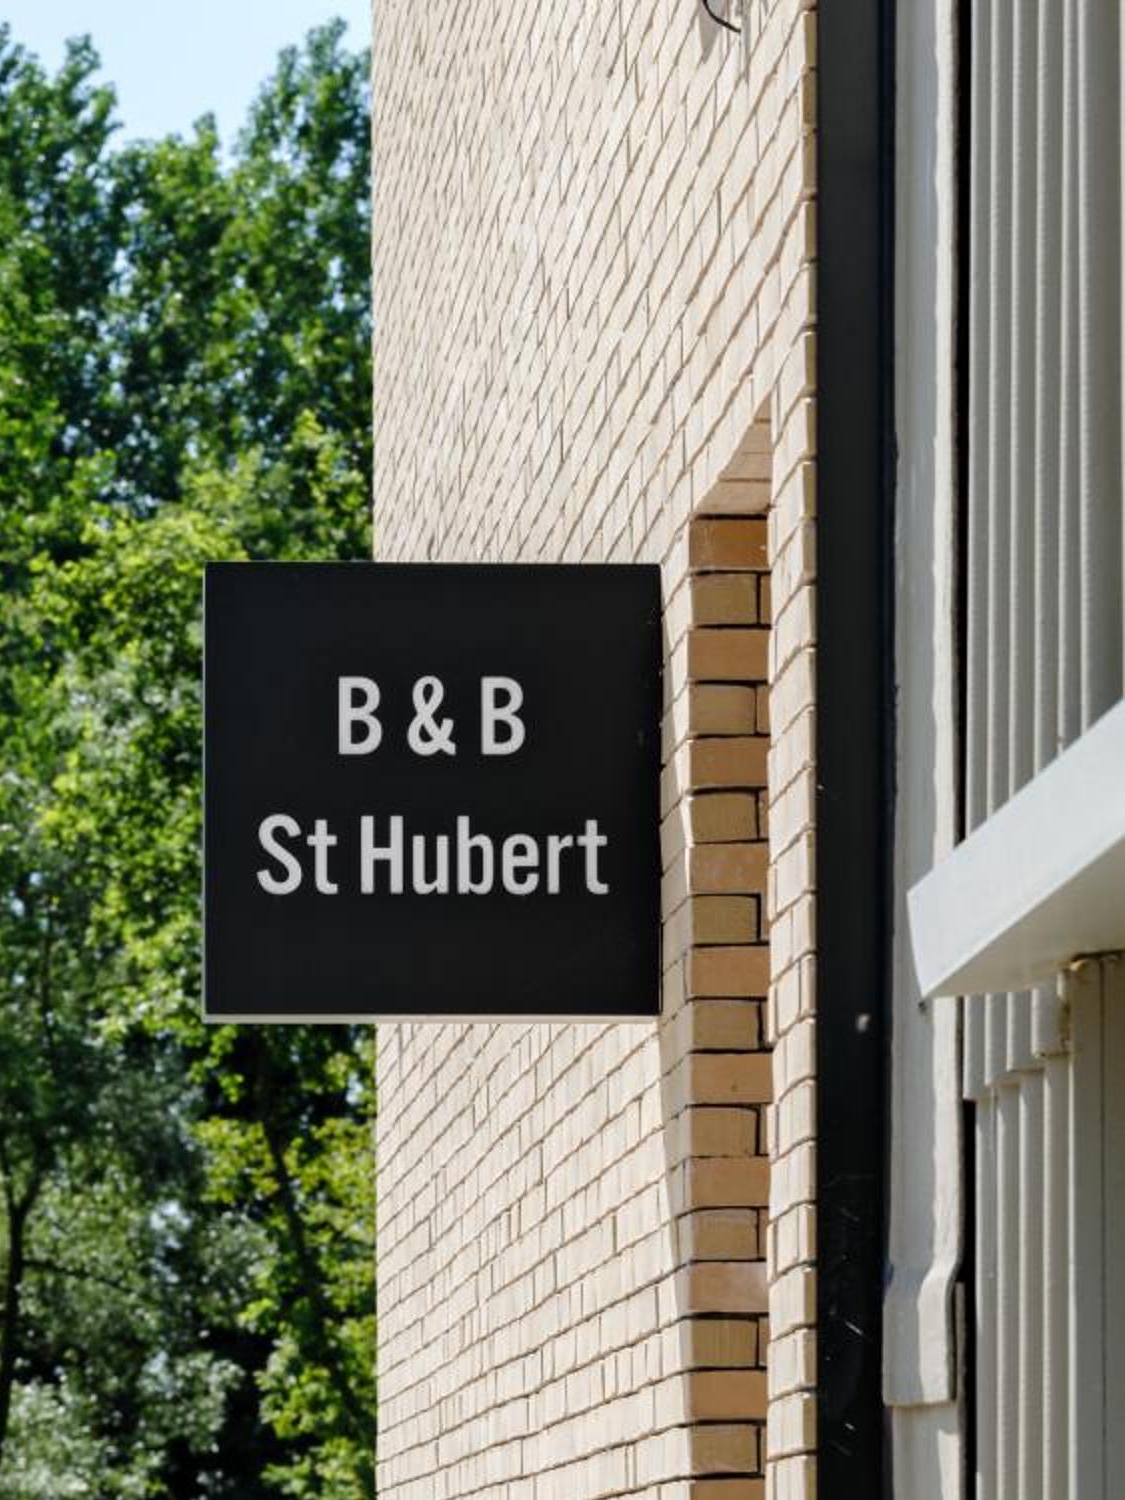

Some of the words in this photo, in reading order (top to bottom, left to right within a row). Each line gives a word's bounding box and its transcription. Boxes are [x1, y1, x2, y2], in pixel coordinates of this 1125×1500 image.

[338, 676, 382, 755] B
[407, 675, 456, 756] &
[481, 676, 525, 755] B
[257, 814, 338, 895] St
[360, 815, 608, 895] Hubert
